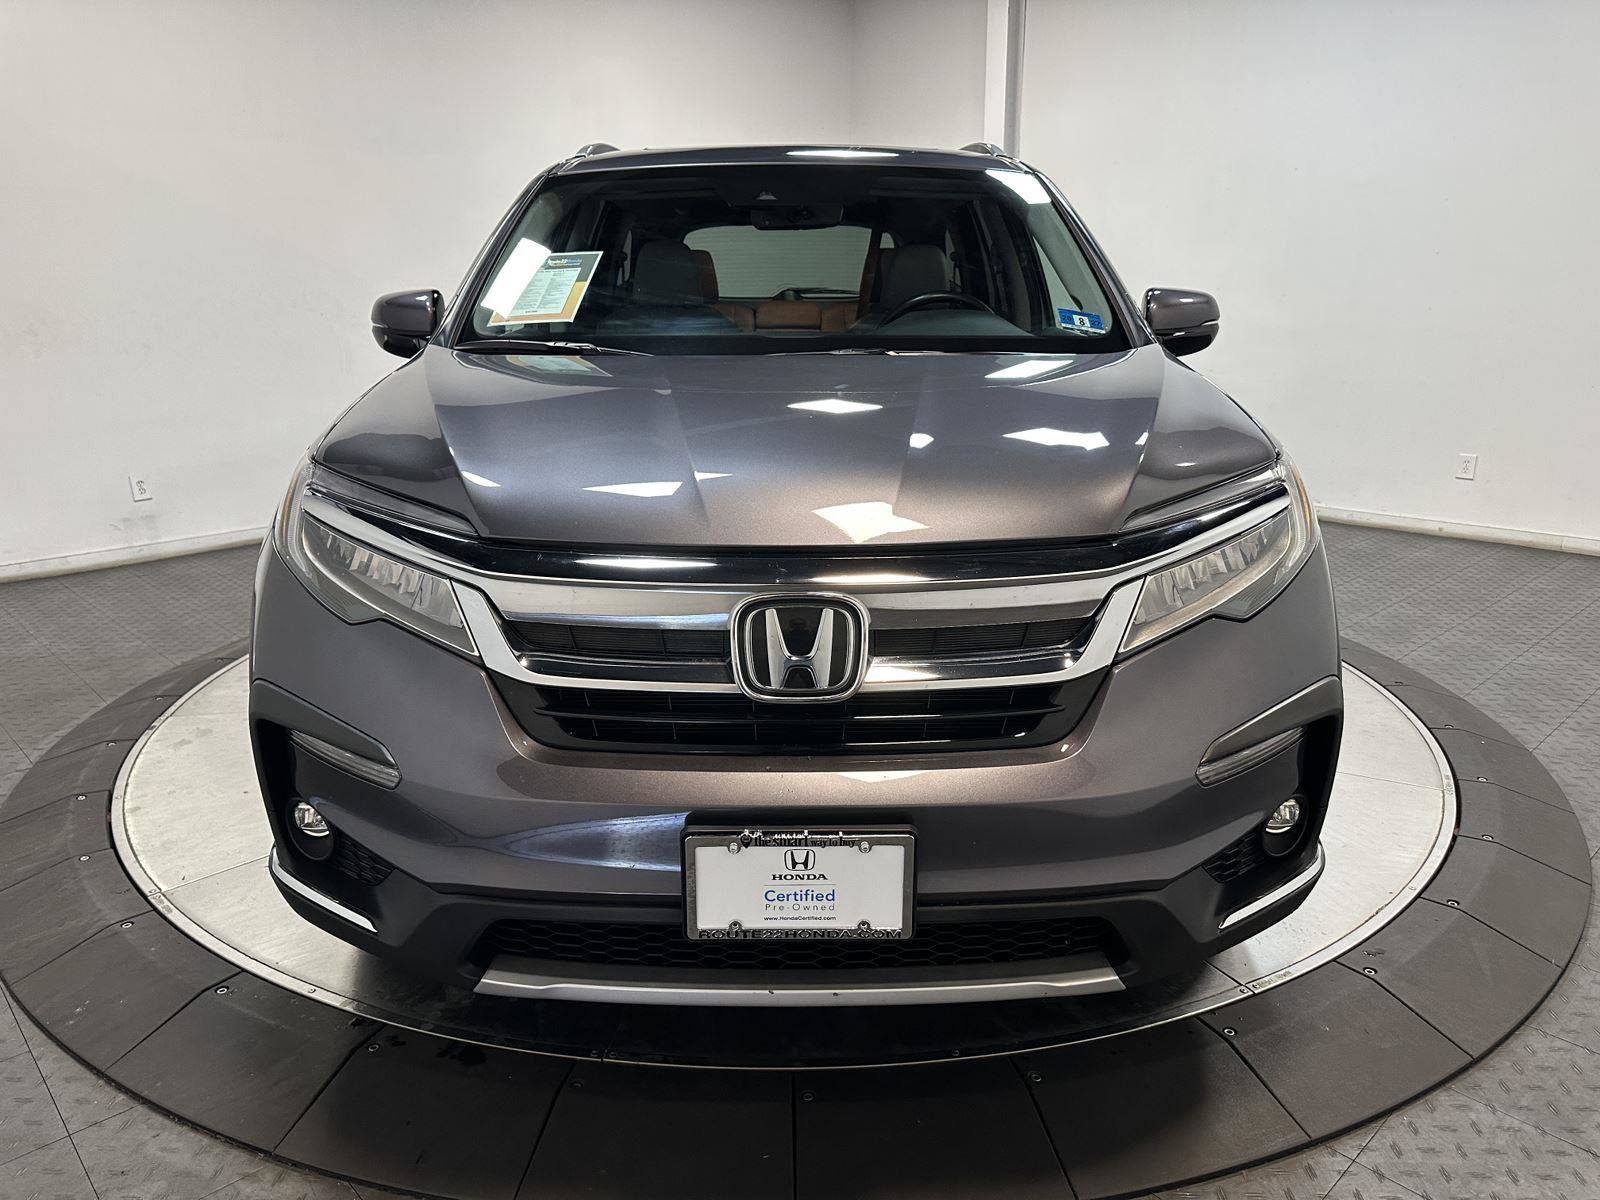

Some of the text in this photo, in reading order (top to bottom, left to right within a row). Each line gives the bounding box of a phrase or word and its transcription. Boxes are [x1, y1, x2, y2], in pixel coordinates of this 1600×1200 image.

[1078, 317, 1086, 326] 8
[810, 840, 826, 849] way
[827, 837, 838, 847] to
[839, 837, 857, 848] buy
[771, 873, 828, 881] HONDA
[763, 889, 836, 902] Certified
[764, 903, 836, 911] Pre-Owned
[698, 929, 903, 939] ROUTE22HONDA.COM
